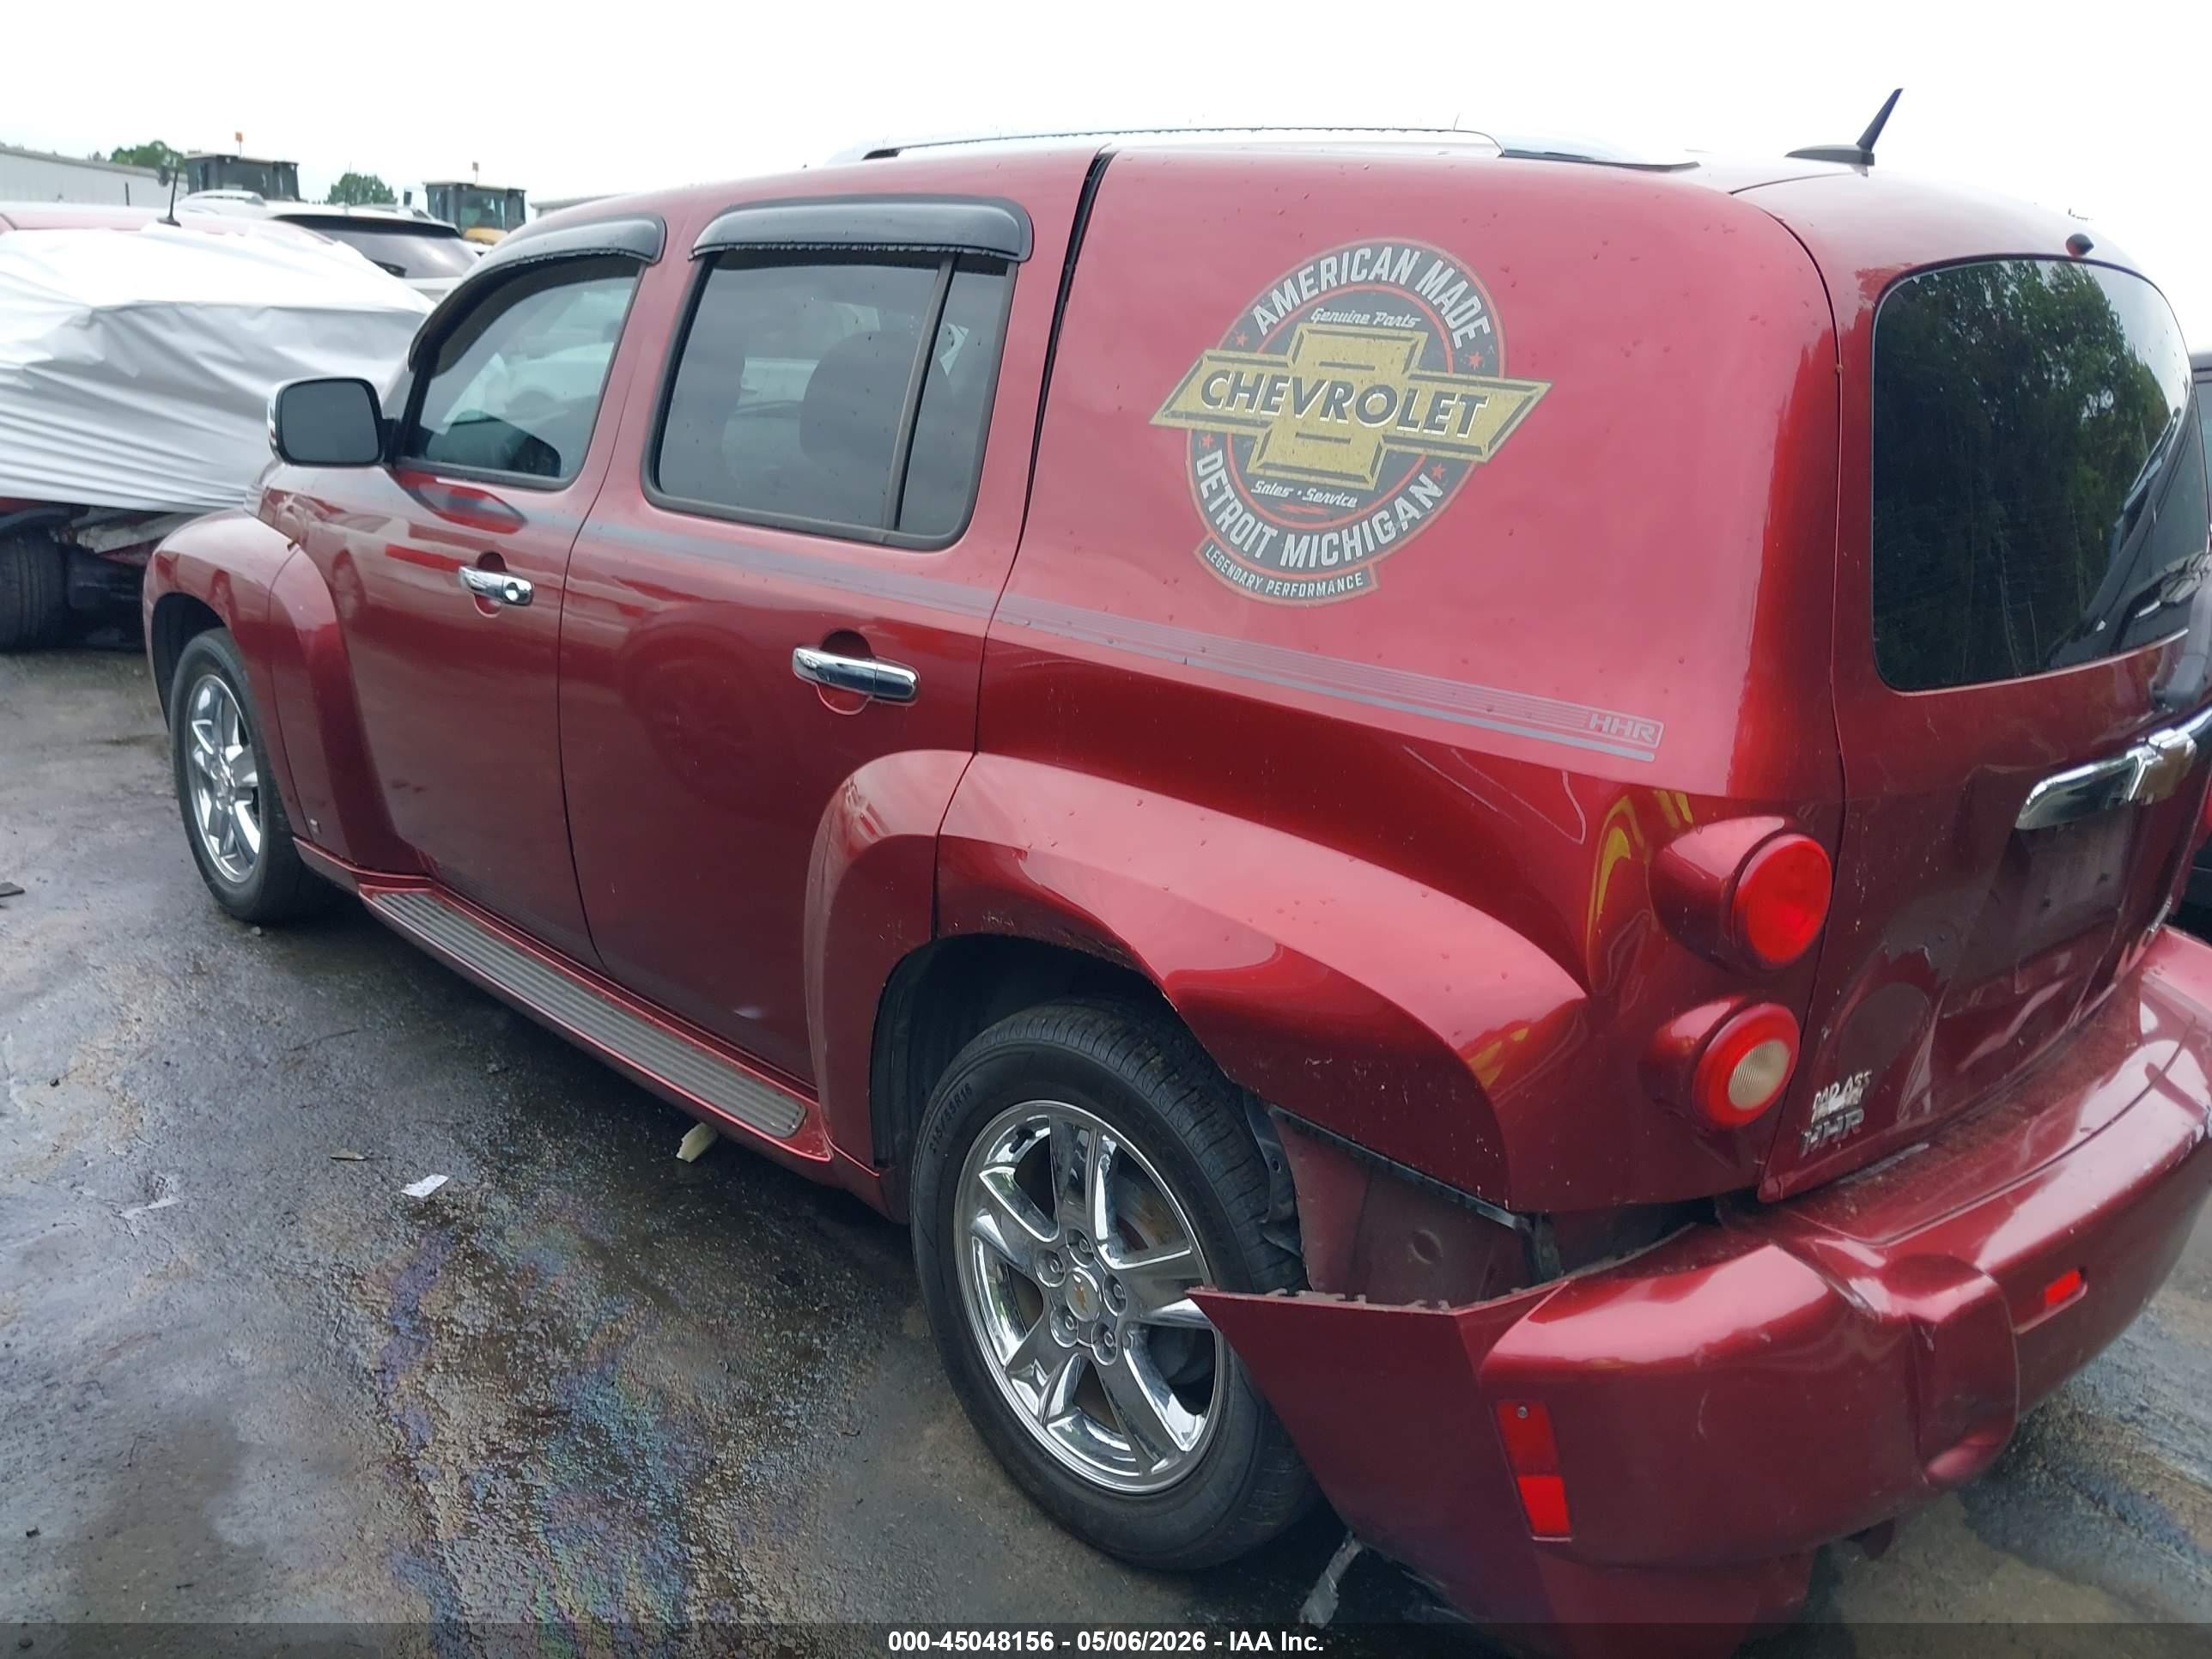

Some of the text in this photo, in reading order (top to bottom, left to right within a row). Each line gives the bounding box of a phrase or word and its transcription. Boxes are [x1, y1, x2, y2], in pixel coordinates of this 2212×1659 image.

[1250, 246, 1491, 349] AMERICAN MADE
[1310, 307, 1422, 328] Genuine Parts
[1200, 369, 1490, 438] CHEVROLET
[1196, 448, 1444, 568] DETROIT MICHIGAN
[1250, 480, 1358, 508] Sales Service
[1205, 544, 1364, 598] LEGENDARY PERFORMANCE
[1589, 713, 1656, 743] HHR
